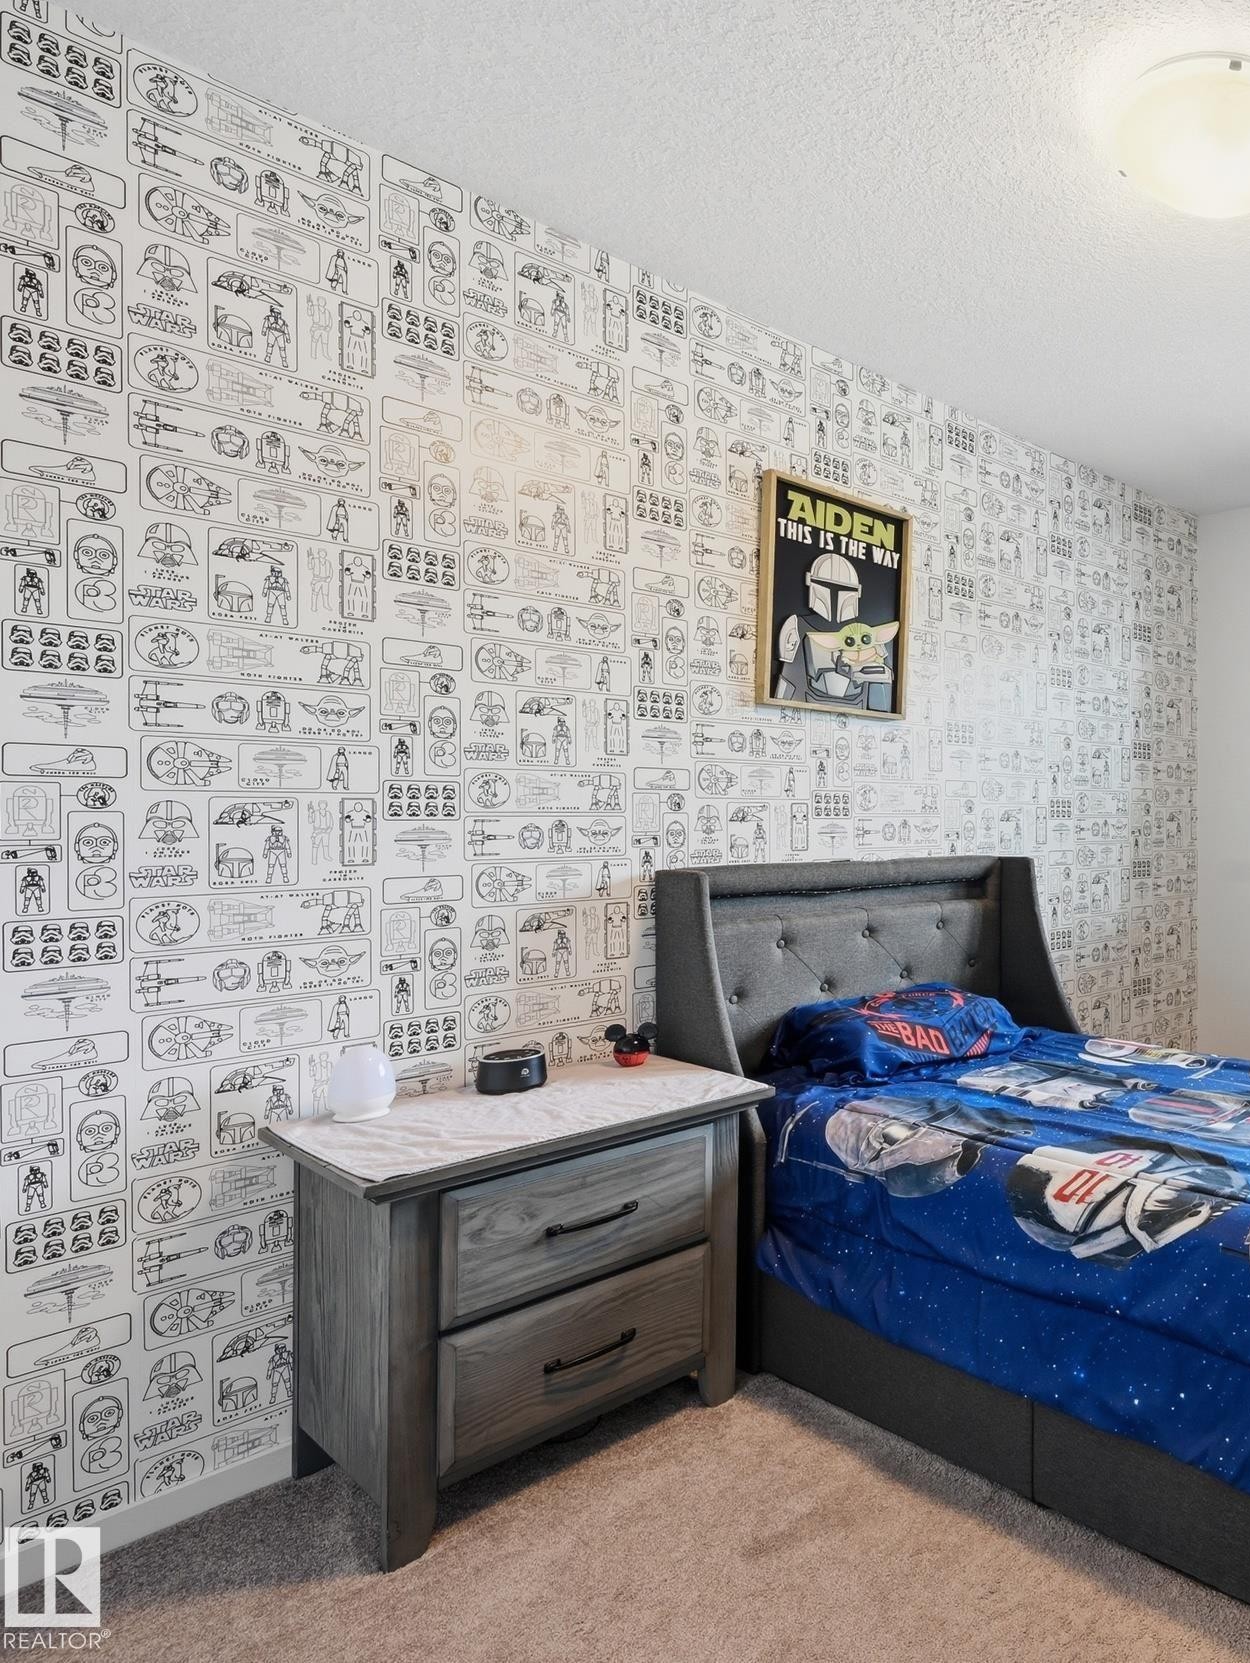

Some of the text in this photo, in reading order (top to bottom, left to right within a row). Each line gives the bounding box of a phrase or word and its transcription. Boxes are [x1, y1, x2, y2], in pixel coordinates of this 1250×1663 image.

[777, 518, 900, 569] THIS IS THE WAY
[788, 490, 895, 550] AIDEN
[874, 1021, 899, 1034] THE
[895, 1021, 950, 1055] BAD
